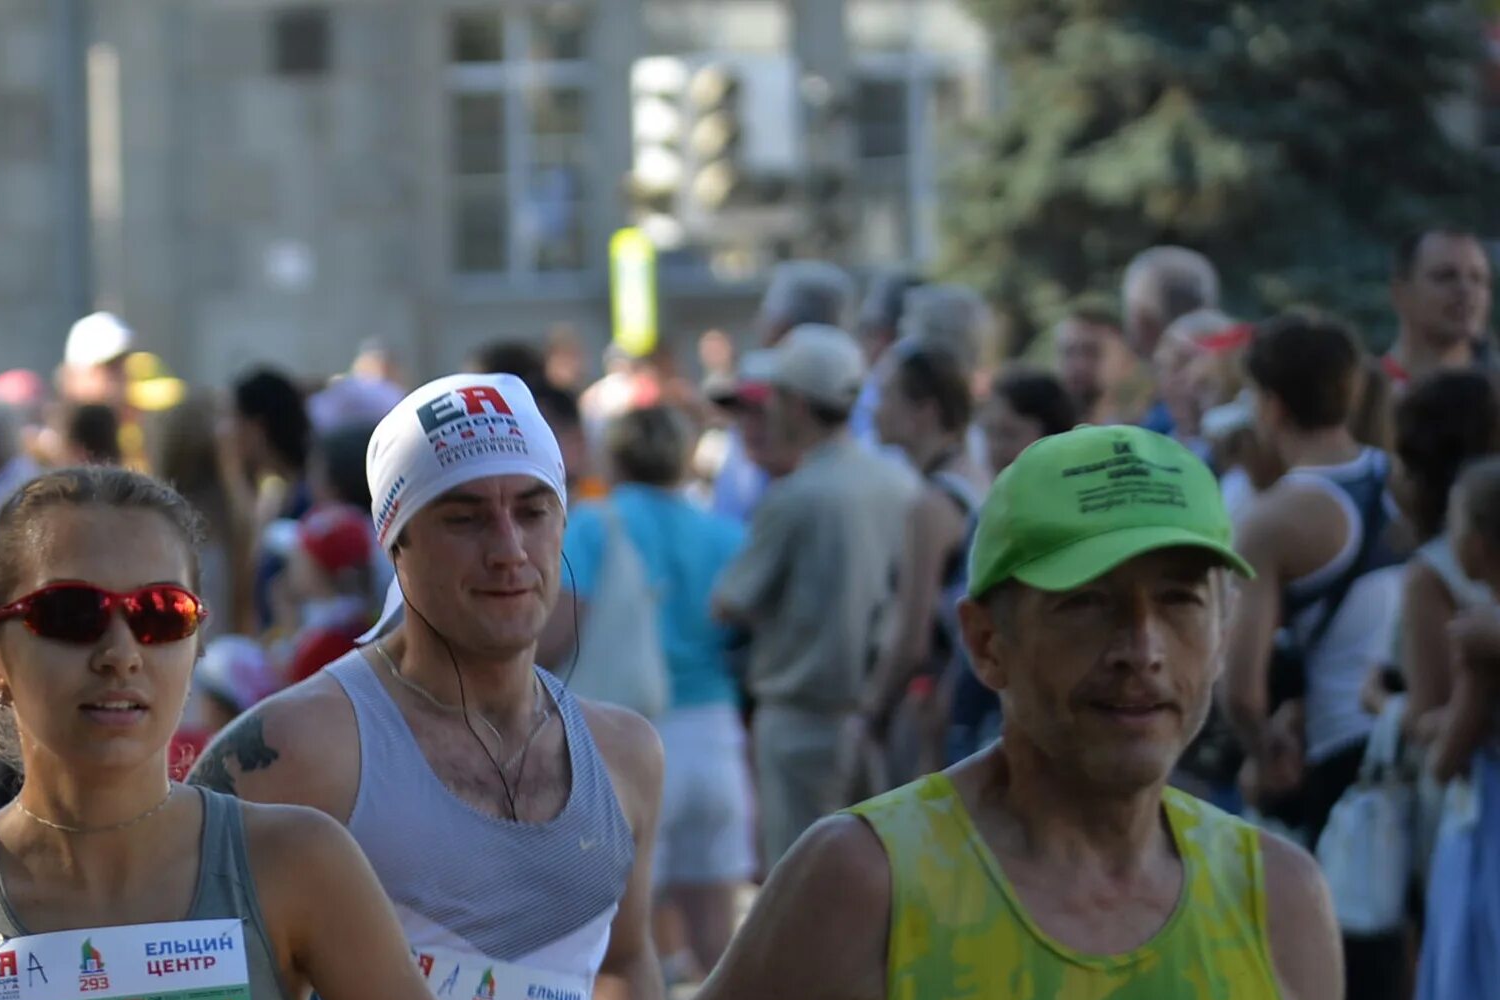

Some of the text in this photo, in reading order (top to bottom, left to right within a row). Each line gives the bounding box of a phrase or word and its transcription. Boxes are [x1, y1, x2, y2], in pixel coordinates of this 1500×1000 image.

[428, 416, 519, 444] EUROPE
[435, 427, 523, 453] ASIA
[145, 936, 234, 956] ЕЛЬЦИН
[147, 956, 216, 977] ЦЕНТР
[79, 977, 109, 992] 293
